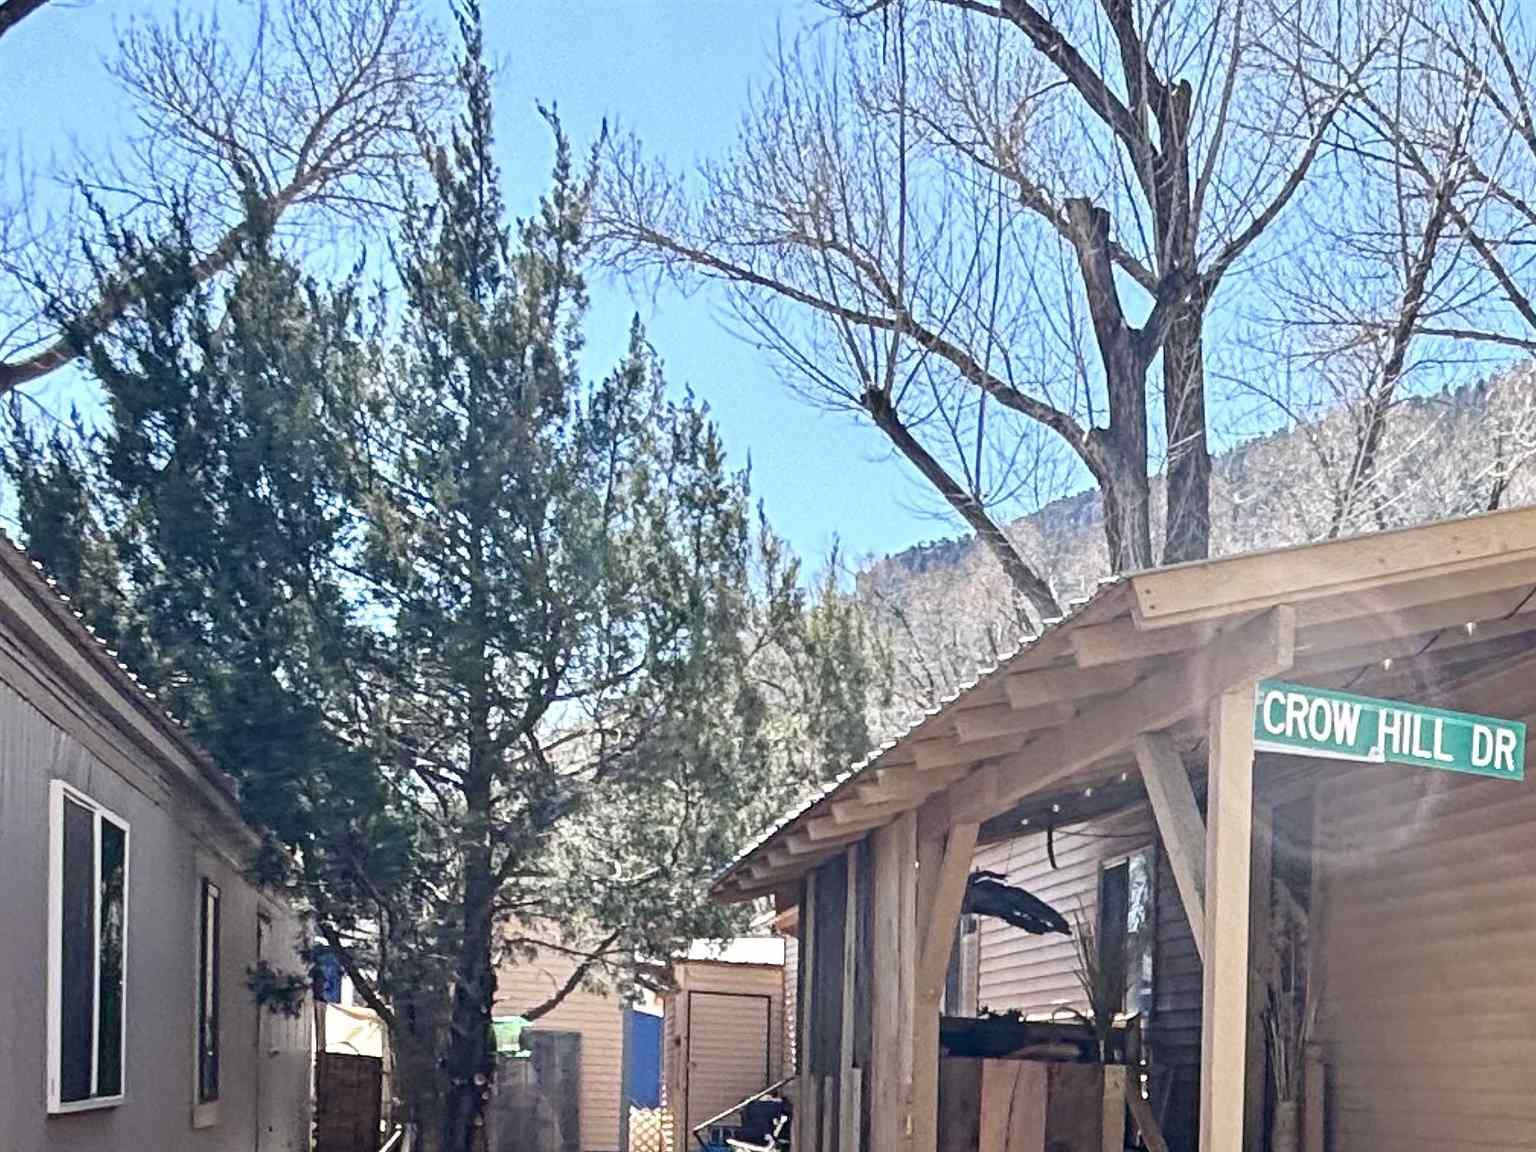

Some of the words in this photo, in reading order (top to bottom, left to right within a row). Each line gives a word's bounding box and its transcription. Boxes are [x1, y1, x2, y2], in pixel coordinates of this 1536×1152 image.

[1262, 690, 1361, 746] CROW
[1377, 707, 1454, 762] HILL
[1470, 723, 1517, 772] DR
